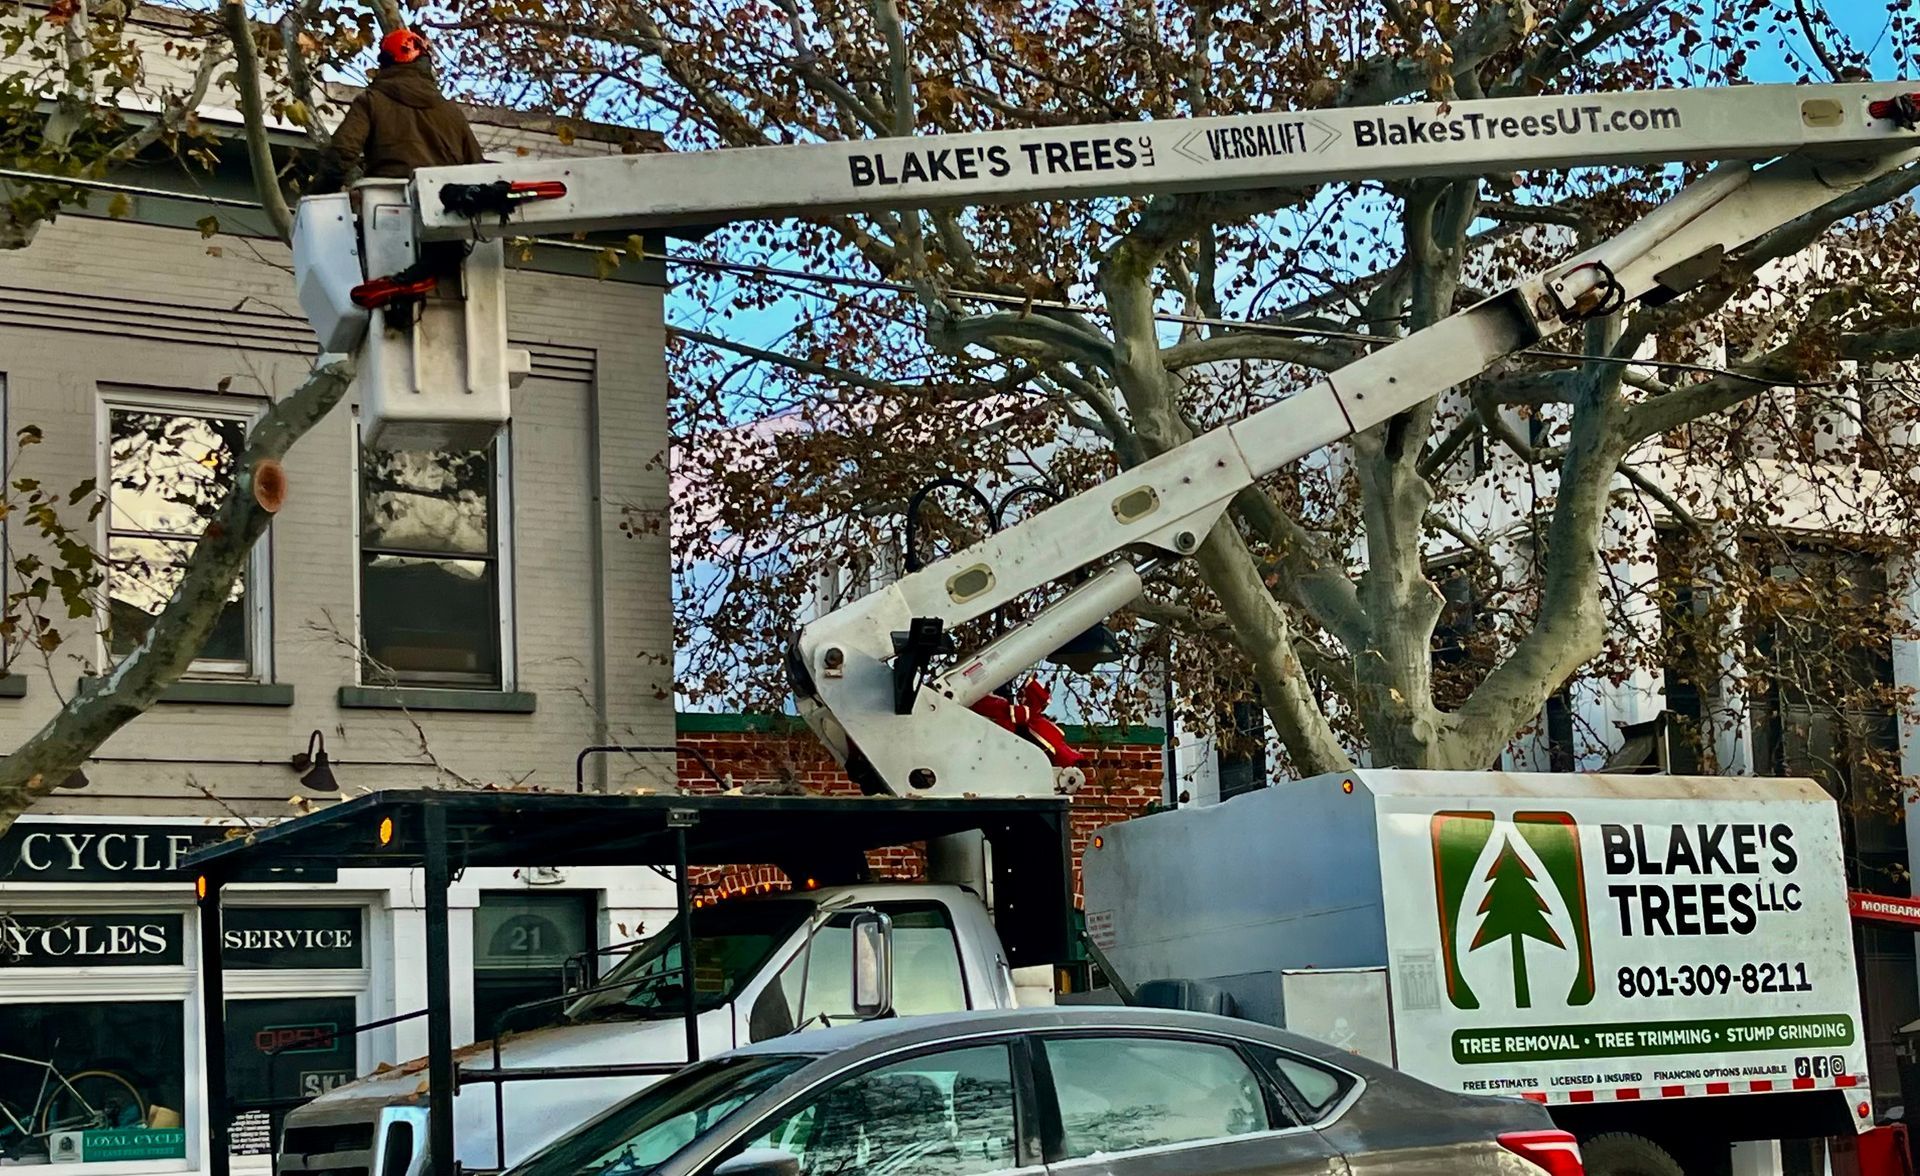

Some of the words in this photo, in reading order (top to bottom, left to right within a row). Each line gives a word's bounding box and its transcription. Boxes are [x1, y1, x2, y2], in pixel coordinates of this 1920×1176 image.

[1205, 122, 1307, 161] VERSALIFT
[1353, 105, 1682, 147] BlakesTreesUT.com
[848, 145, 1011, 187] BLAKE'S
[1020, 137, 1138, 175] TREES
[1138, 135, 1156, 168] LLC
[1600, 823, 1799, 875] BLAKE'S
[1608, 882, 1757, 937] TREES
[1755, 882, 1803, 912] LLC
[0, 924, 168, 956] YCLES
[224, 929, 353, 949] SERVICE
[510, 926, 541, 951] 21
[1617, 962, 1812, 998] 801-309-8211
[1460, 1037, 1501, 1055] TREE
[1504, 1034, 1580, 1053] REMOVAL
[1595, 1031, 1635, 1048] TREE
[1637, 1029, 1712, 1047] TRIMMING
[1726, 1025, 1775, 1043] STUMP
[1778, 1023, 1847, 1041] GRINDING
[1463, 1080, 1487, 1091] FREE
[1489, 1078, 1539, 1090] ESTIMATES
[1550, 1074, 1594, 1086] LICENSED
[1596, 1074, 1603, 1084] &
[1604, 1072, 1643, 1083] INSURED
[1653, 1069, 1701, 1081] FINANCING
[1703, 1067, 1741, 1079] OPTIONS
[1742, 1064, 1788, 1076] AVAILABLE
[86, 1135, 131, 1148] LOYAL
[134, 1133, 184, 1145] CYCLE
